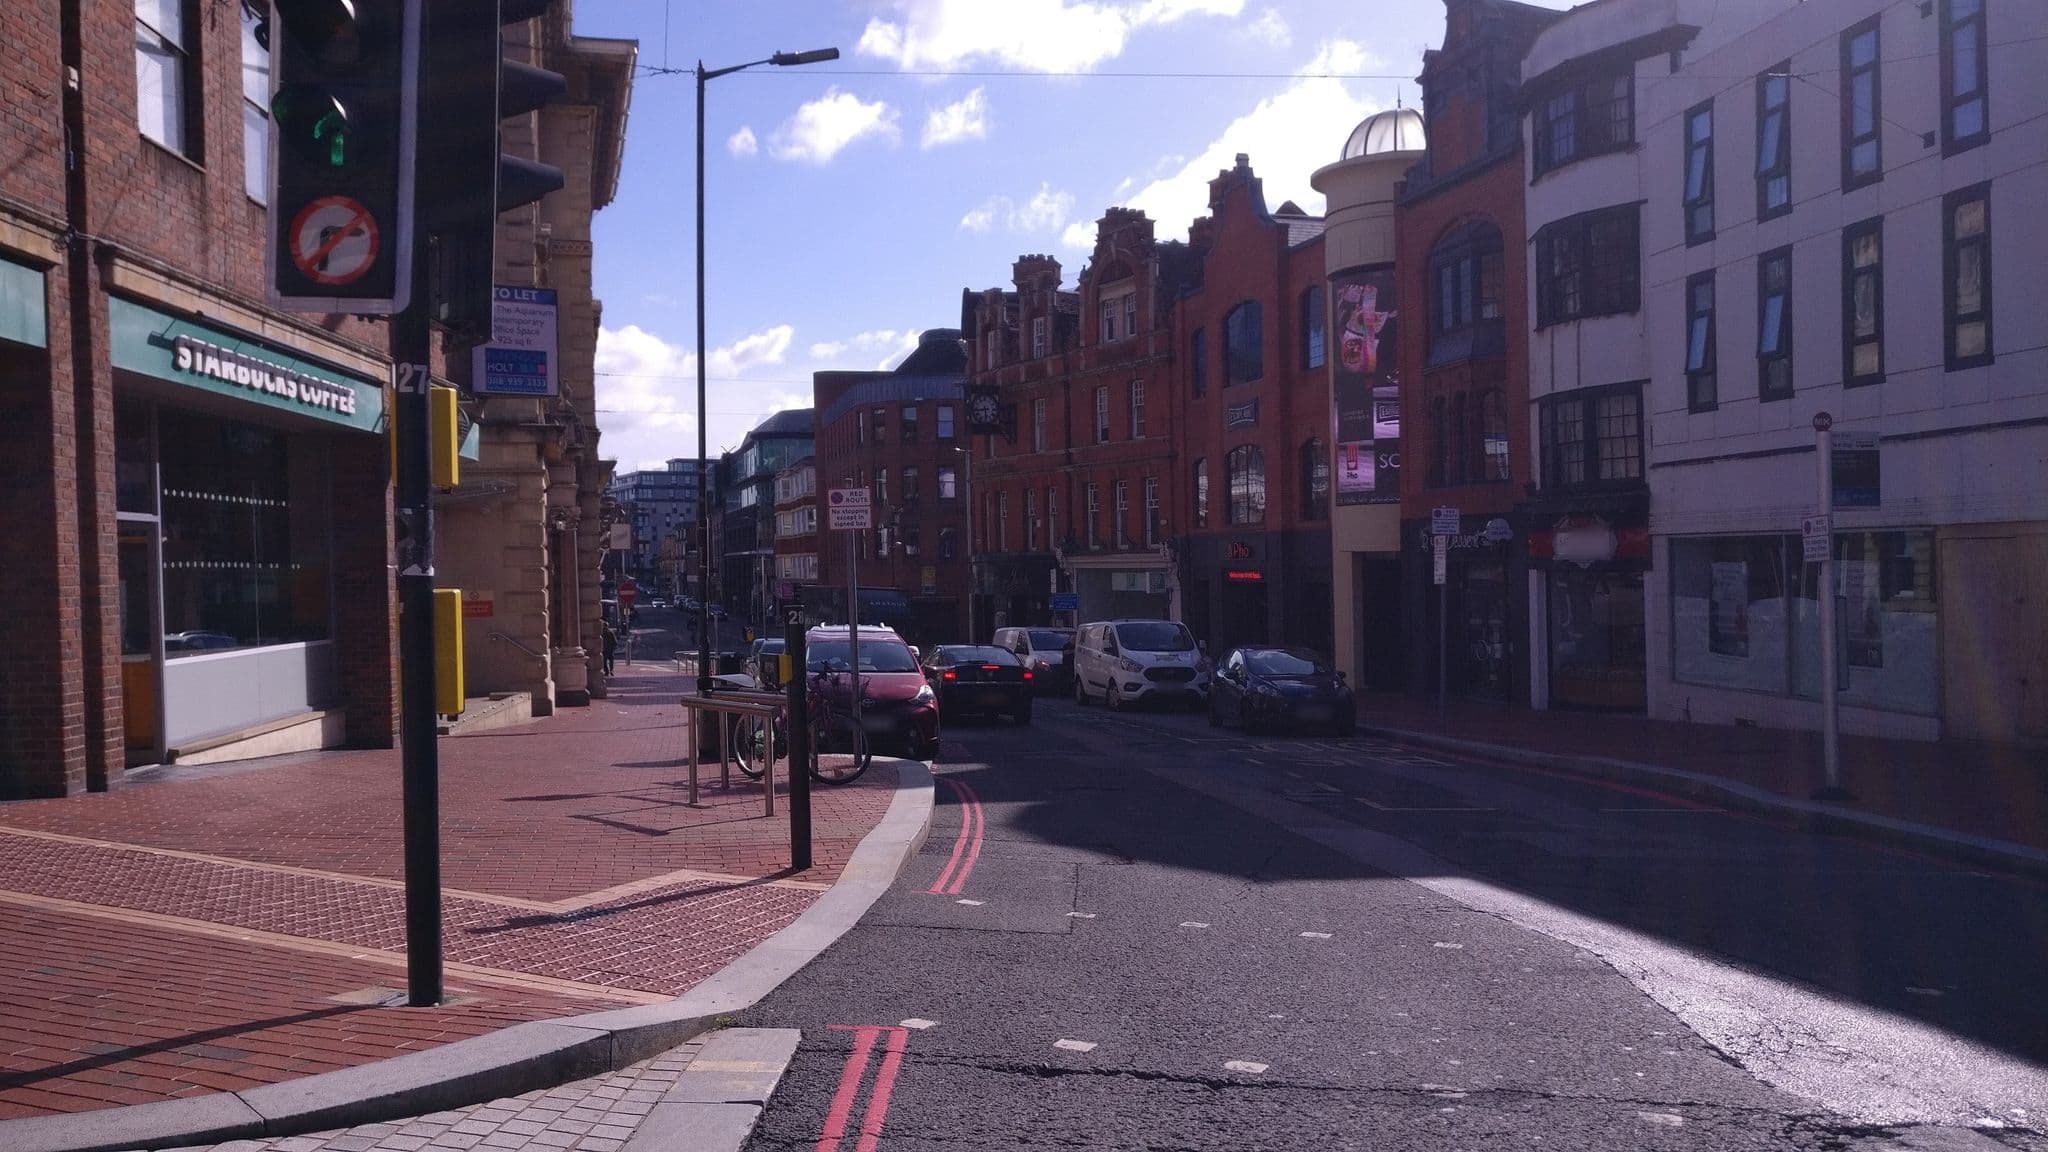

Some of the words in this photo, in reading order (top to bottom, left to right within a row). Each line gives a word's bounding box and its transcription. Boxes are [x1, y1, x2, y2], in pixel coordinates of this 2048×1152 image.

[514, 289, 538, 300] LET
[175, 334, 297, 400] STARBUCKS
[295, 373, 356, 415] COFFEE
[400, 362, 428, 395] 27
[1233, 542, 1249, 559] Pho
